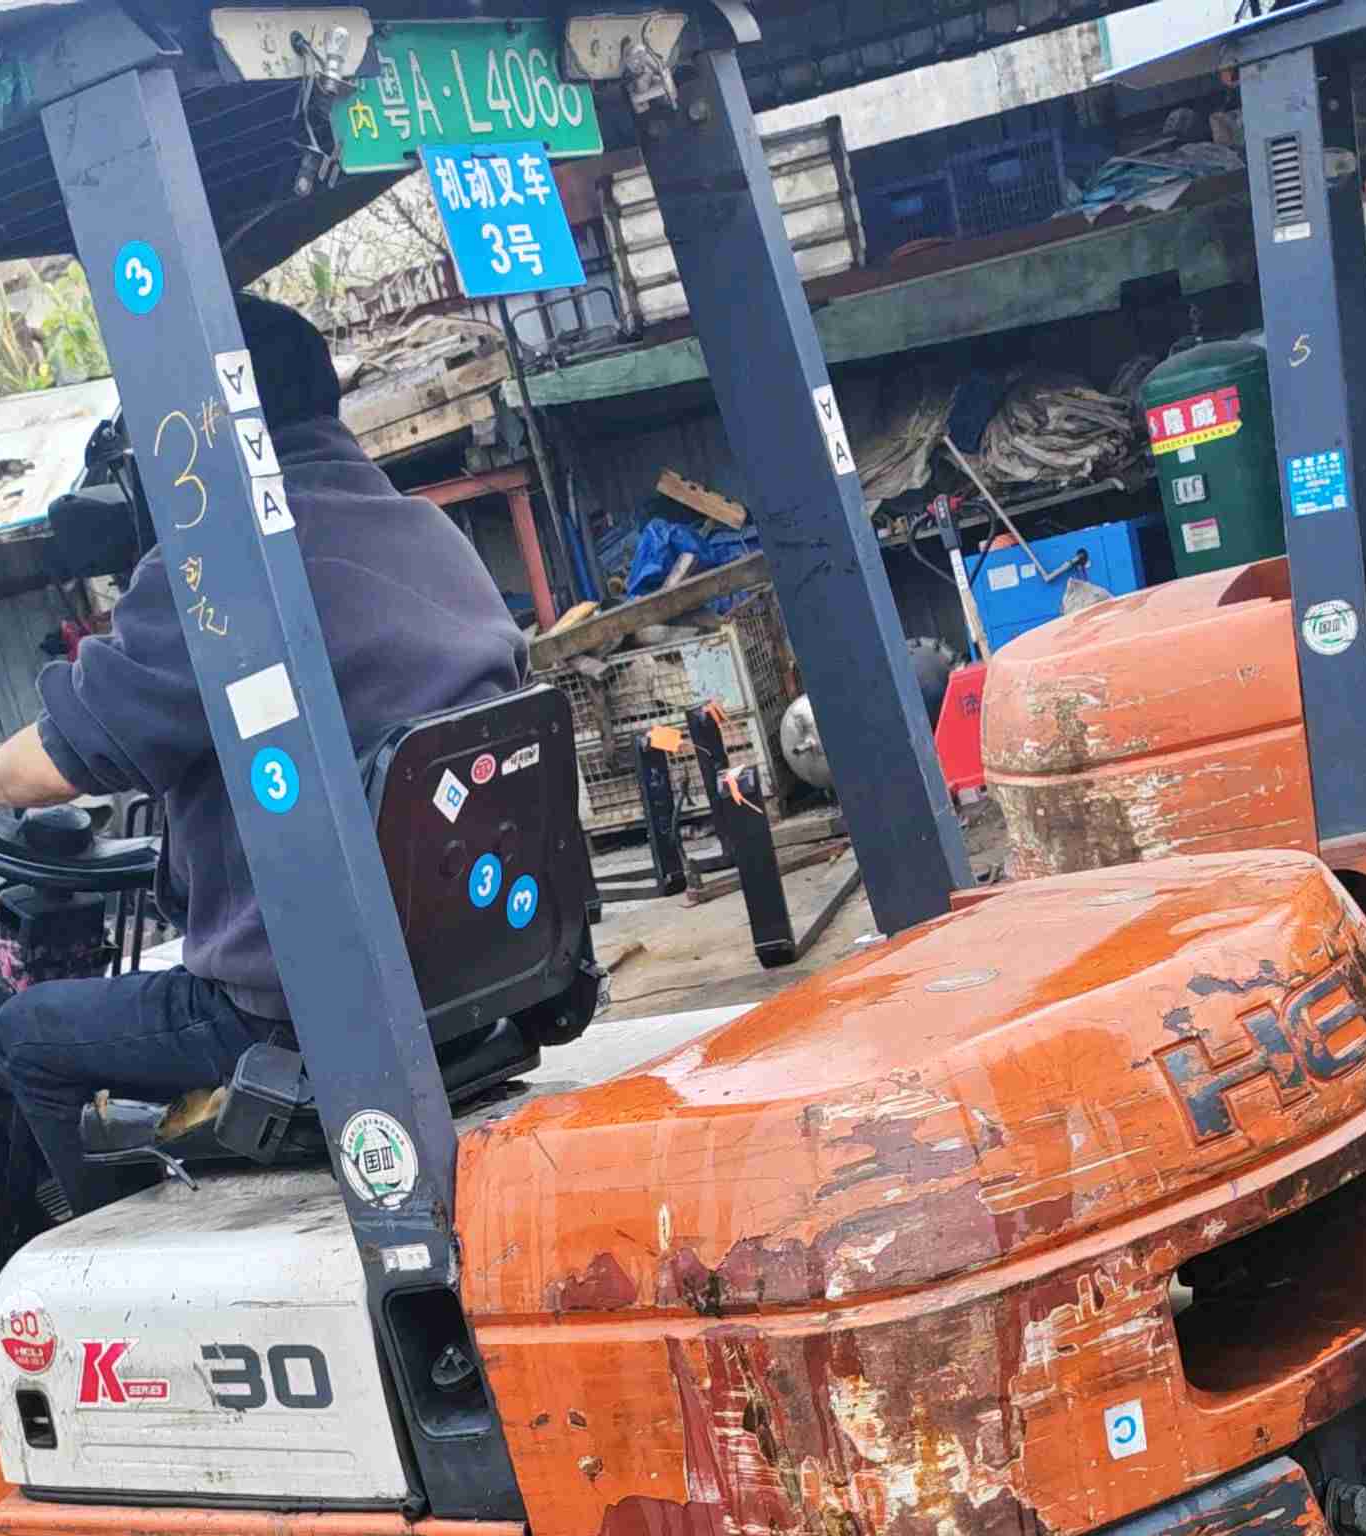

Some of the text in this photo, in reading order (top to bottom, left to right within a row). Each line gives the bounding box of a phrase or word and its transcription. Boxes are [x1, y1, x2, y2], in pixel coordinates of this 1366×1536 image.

[435, 152, 551, 211] 机动叉车
[482, 222, 544, 275] 3号
[124, 256, 154, 298] 3
[1287, 334, 1312, 368] 5
[222, 365, 244, 395] A
[818, 396, 833, 421] A
[242, 430, 264, 461] A
[835, 439, 849, 465] A
[263, 489, 283, 520] A
[263, 760, 288, 800] 3
[476, 864, 495, 897] 3
[513, 888, 533, 913] 3
[79, 1342, 133, 1403] K
[199, 1344, 335, 1409] 30
